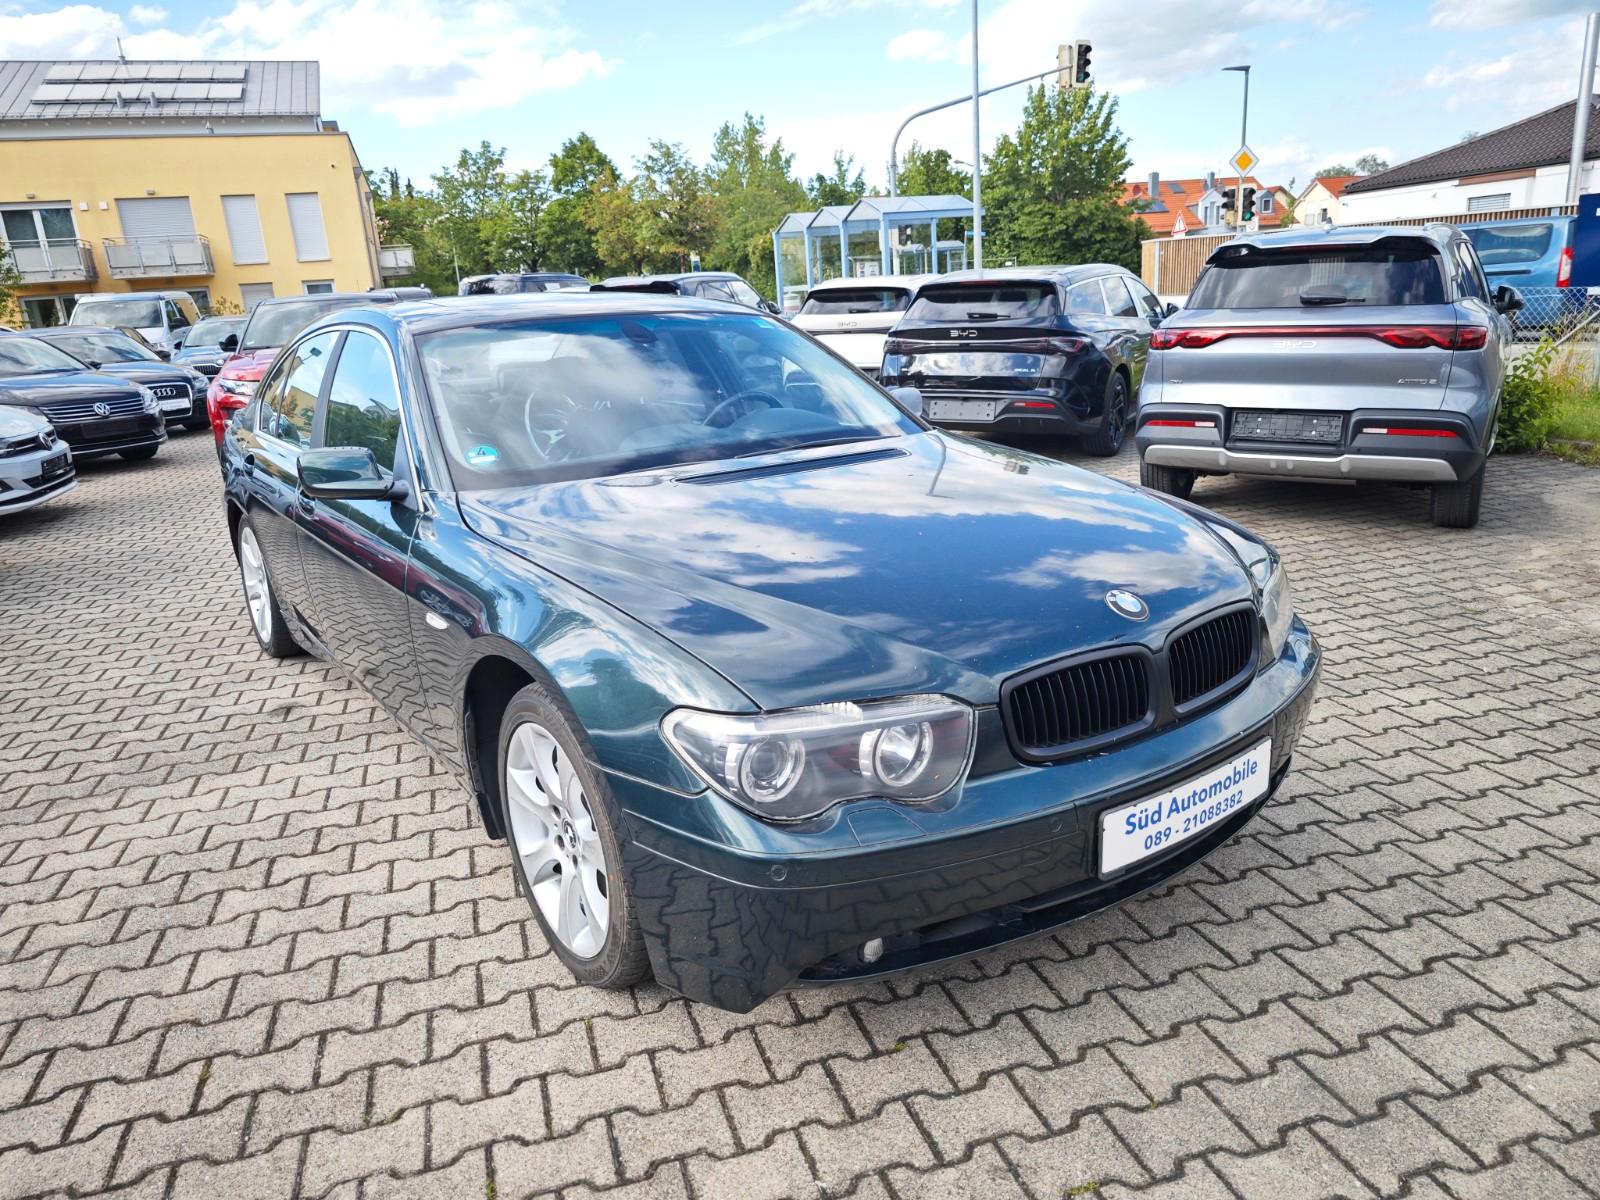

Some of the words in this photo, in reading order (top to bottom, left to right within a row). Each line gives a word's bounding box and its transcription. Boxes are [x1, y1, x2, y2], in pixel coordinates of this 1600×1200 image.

[949, 329, 978, 338] BYD
[1271, 340, 1317, 350] BYD
[1124, 802, 1162, 836] Süd
[1166, 758, 1258, 819] Automobile
[1144, 827, 1172, 850] 089
[1183, 790, 1243, 833] 21088382
